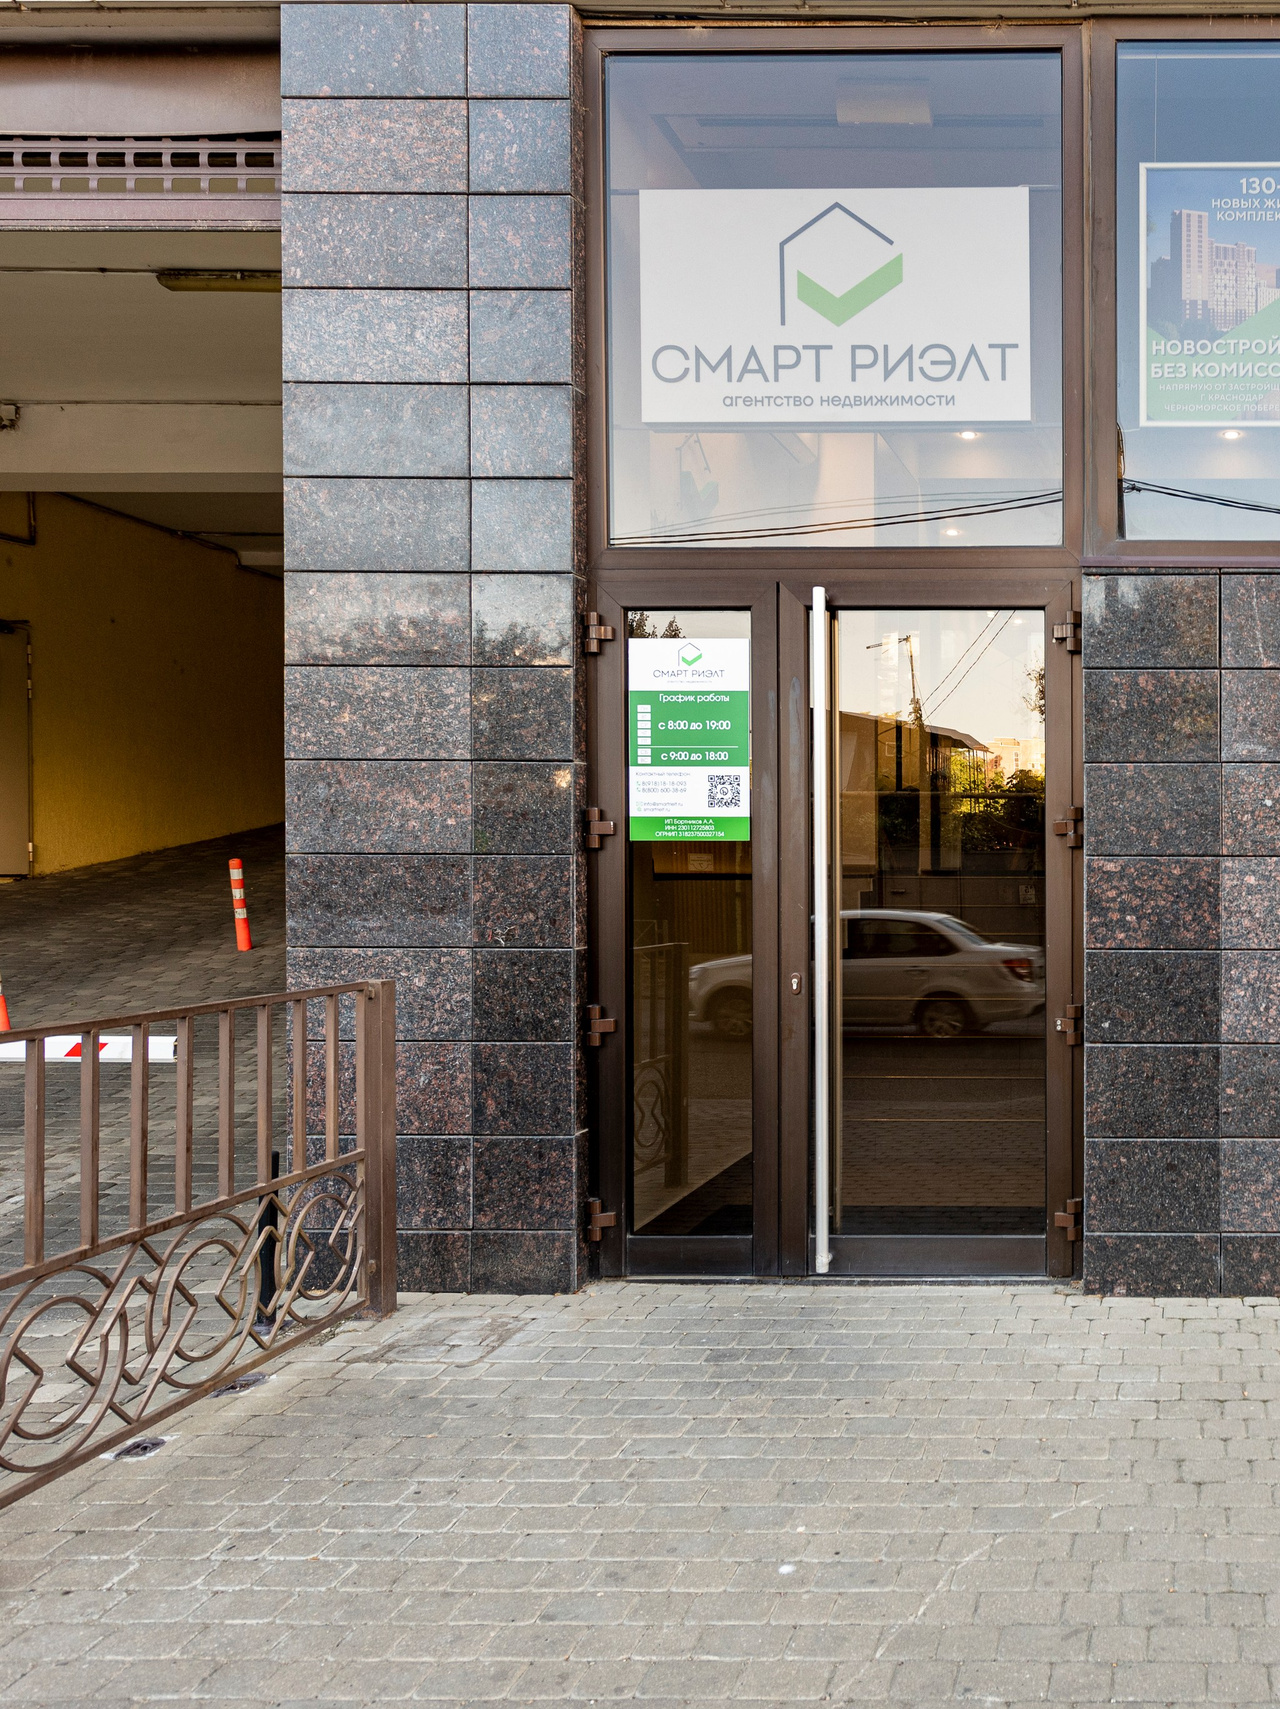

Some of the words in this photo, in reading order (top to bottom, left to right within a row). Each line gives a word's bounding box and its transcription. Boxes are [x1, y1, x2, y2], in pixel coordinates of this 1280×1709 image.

[1212, 199, 1263, 209] НОВЫХ
[652, 344, 833, 383] СМАРТ
[851, 343, 1019, 382] РИЭЛТ
[1151, 363, 1187, 378] БЕЗ
[1160, 383, 1212, 391] НАПРЯМУЮ
[1214, 383, 1226, 391] ОТ
[722, 395, 814, 407] агентство
[820, 394, 956, 408] недвижимости
[1209, 394, 1264, 402] КРАСНОДАР
[1165, 404, 1242, 412] ЧЕРНОМОРСКОЕ
[653, 670, 688, 678] СМАРТ
[692, 670, 725, 678] РИЭЛТ
[659, 694, 696, 703] График
[697, 693, 730, 703] работы
[658, 722, 665, 730] с
[668, 721, 688, 730] 8:00
[690, 722, 702, 730] до
[706, 721, 731, 730] 19:00
[670, 752, 689, 760] 9:00
[690, 753, 702, 761] до
[705, 752, 728, 760] 18:00
